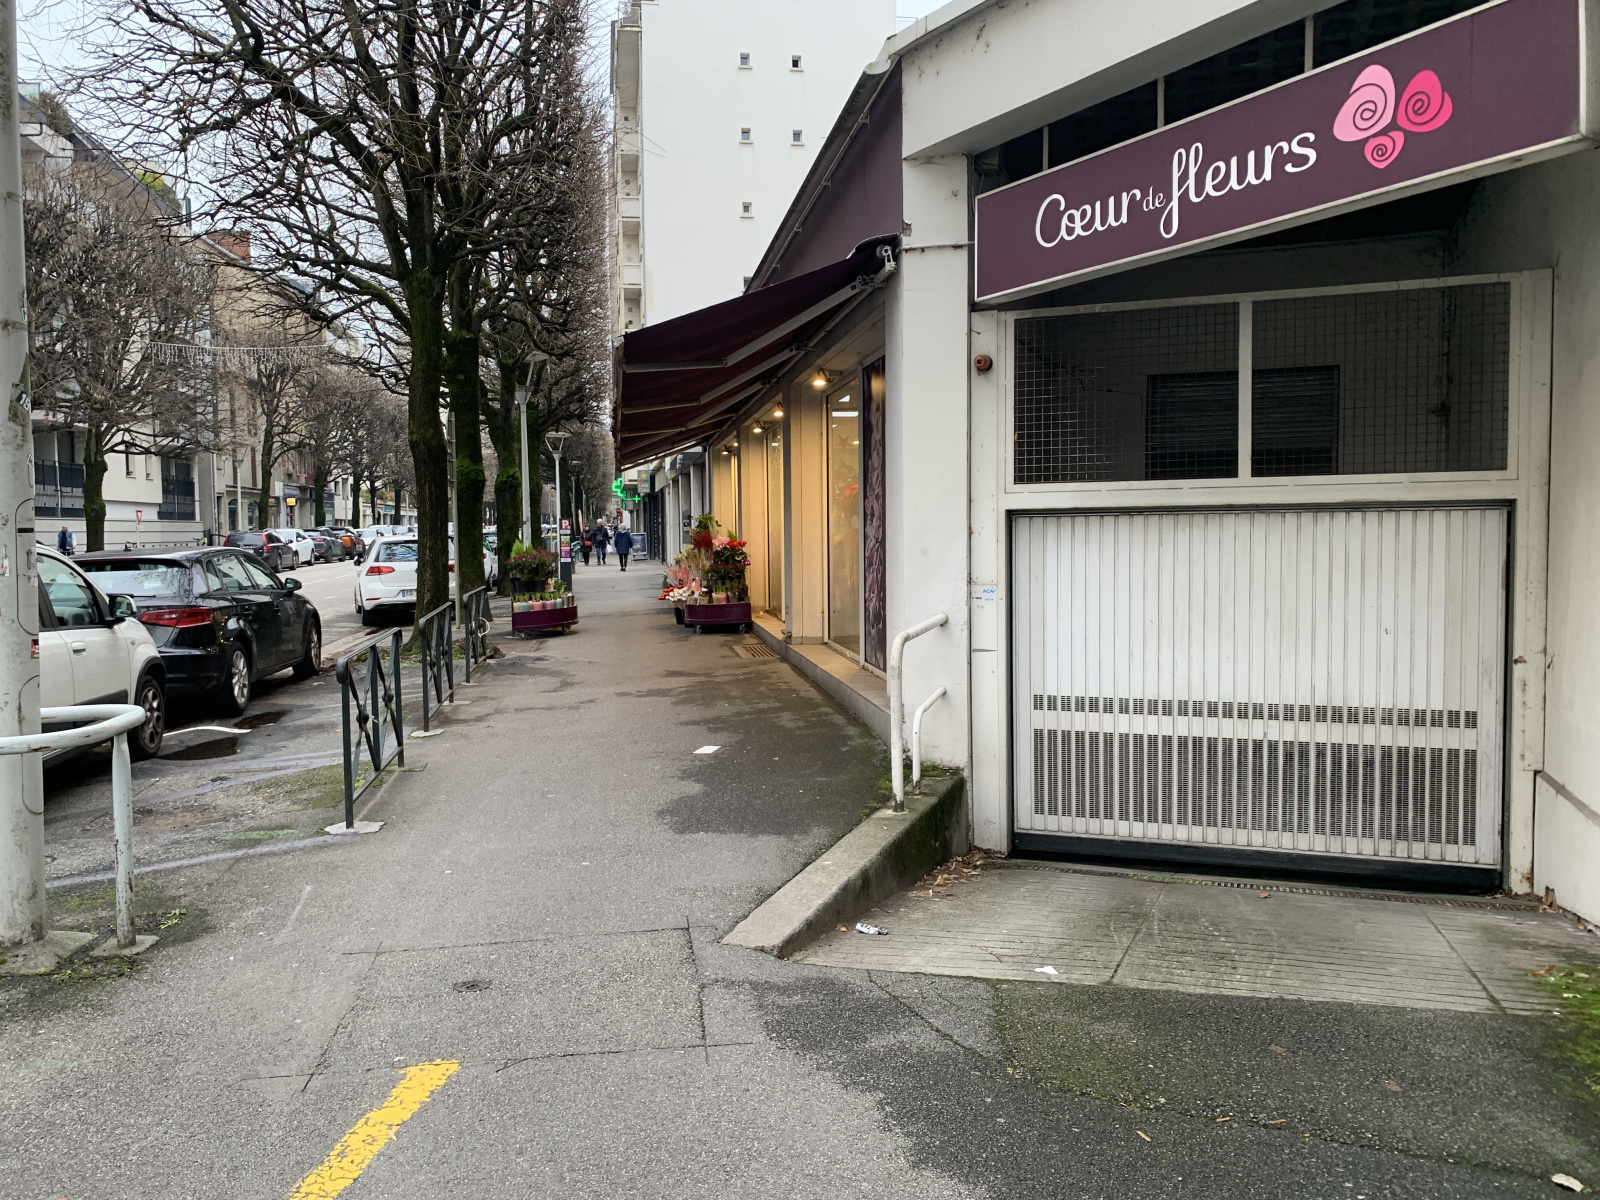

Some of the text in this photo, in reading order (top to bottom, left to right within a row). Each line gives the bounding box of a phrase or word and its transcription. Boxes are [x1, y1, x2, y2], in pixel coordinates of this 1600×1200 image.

[1035, 131, 1317, 248] Cœur de fleurs
